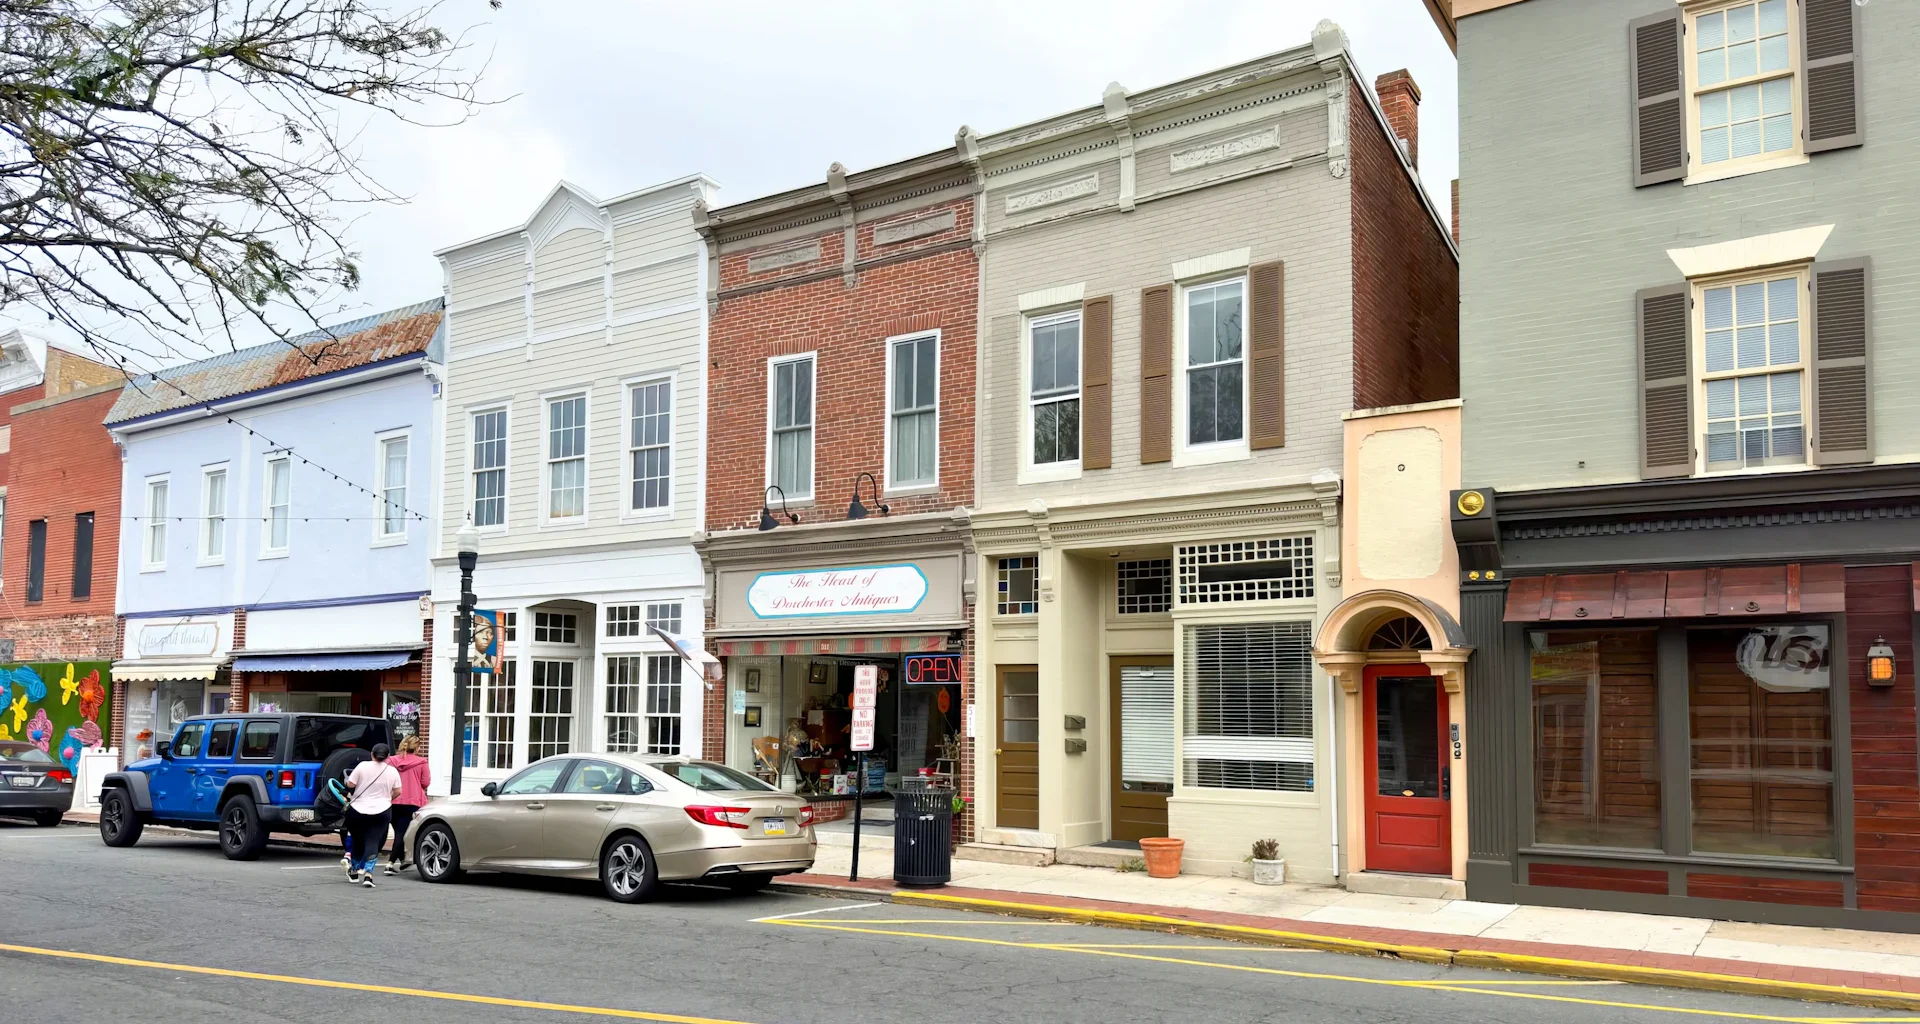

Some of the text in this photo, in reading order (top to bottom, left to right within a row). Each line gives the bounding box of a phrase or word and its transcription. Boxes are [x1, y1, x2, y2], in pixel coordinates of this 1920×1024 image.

[788, 570, 879, 588] The Heart of
[771, 592, 899, 609] Dorchester Antiques
[908, 657, 961, 682] OPEN
[859, 710, 868, 718] NO
